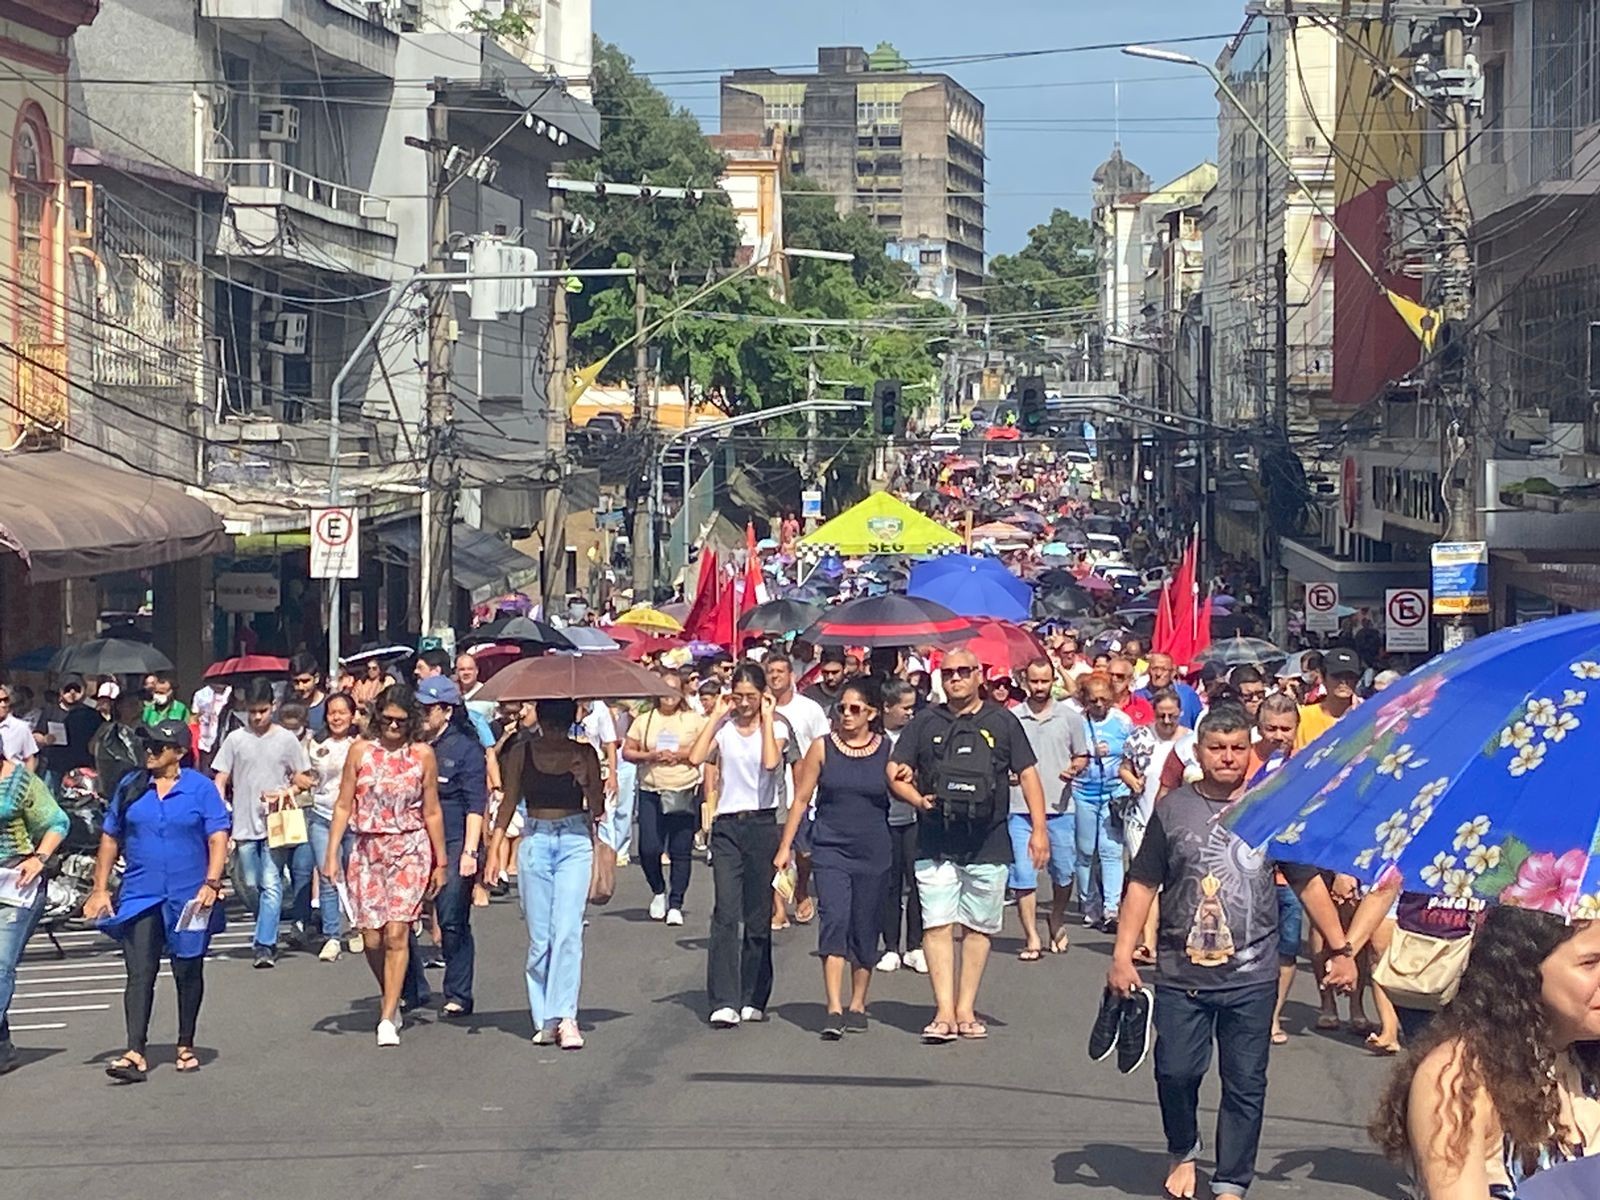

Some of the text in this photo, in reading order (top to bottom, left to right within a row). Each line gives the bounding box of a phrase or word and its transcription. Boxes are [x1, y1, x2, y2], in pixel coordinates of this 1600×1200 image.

[328, 518, 341, 538] E
[868, 543, 904, 552] SEG
[1316, 590, 1328, 606] E
[1399, 598, 1416, 620] E
